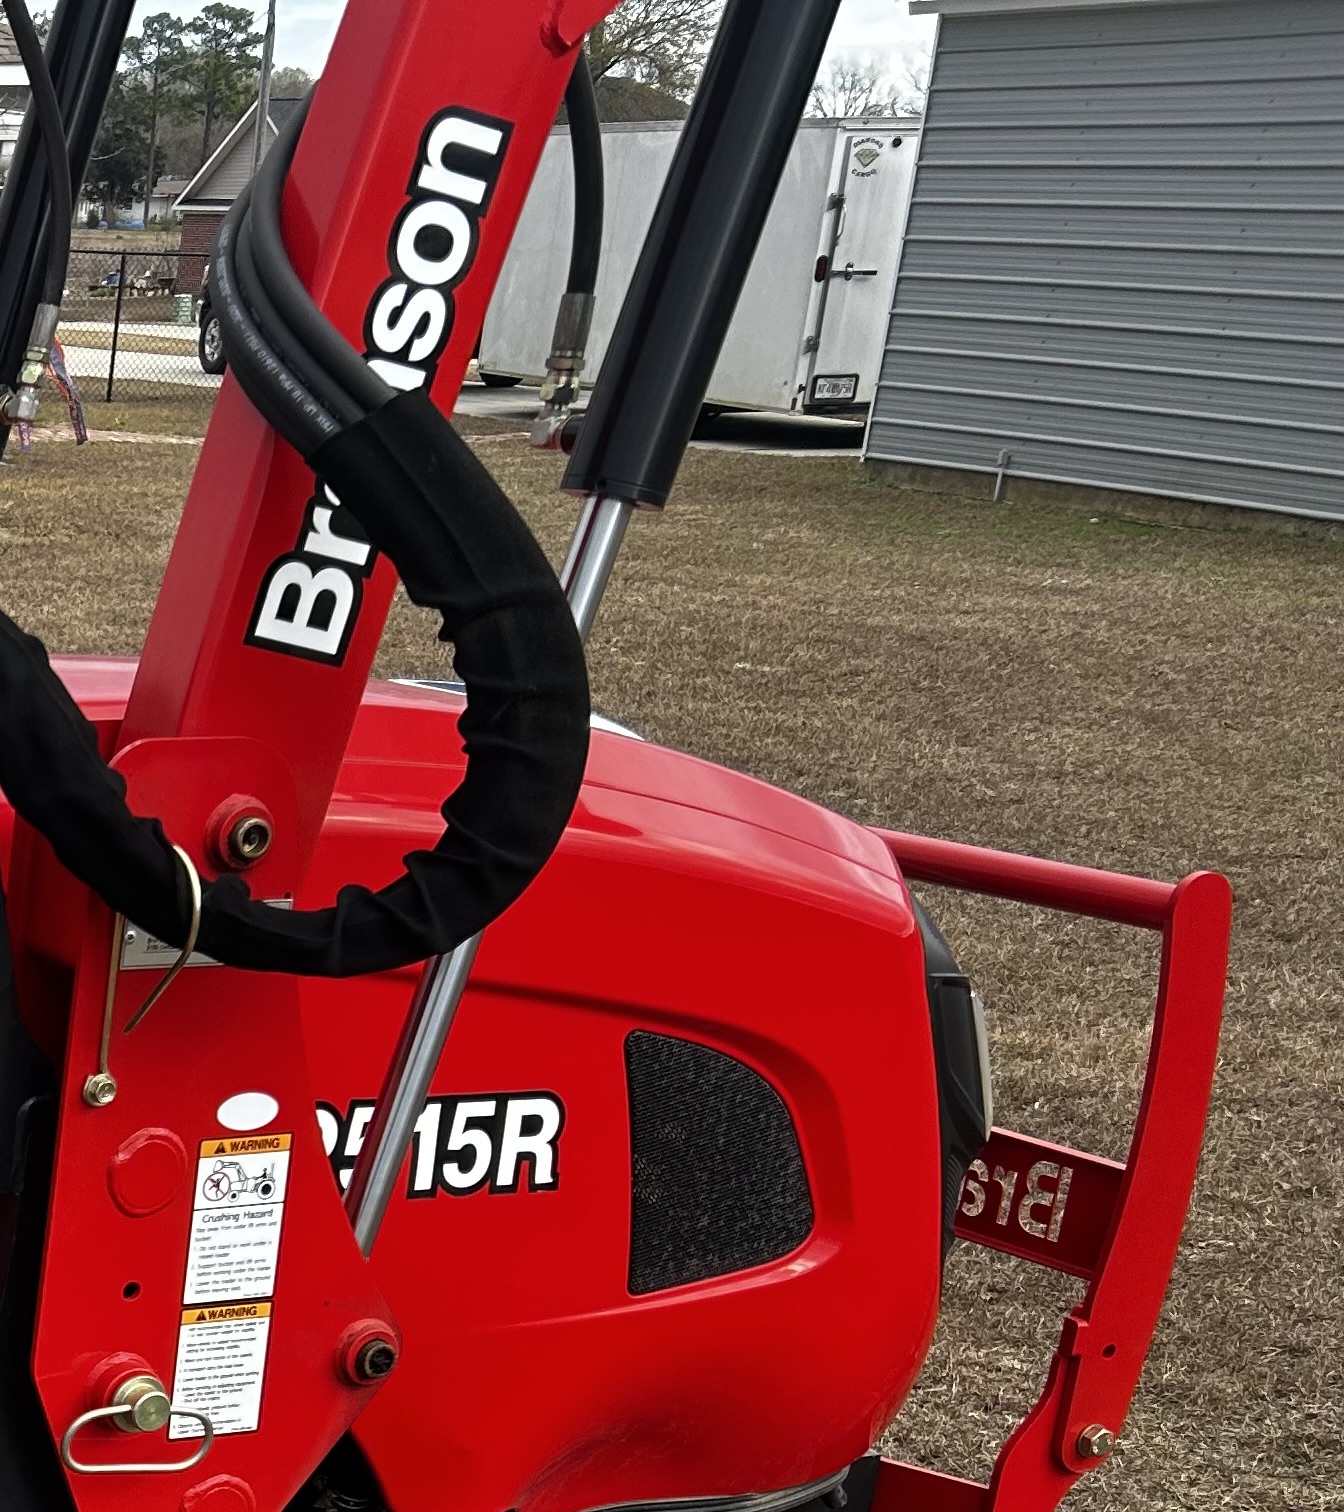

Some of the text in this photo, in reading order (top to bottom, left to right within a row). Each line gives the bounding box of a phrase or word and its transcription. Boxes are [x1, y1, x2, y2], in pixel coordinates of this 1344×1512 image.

[253, 113, 505, 657] Brson
[229, 1137, 281, 1153] WARNING
[202, 1208, 274, 1224] Crushing Hazard
[207, 1306, 258, 1321] WARNING
